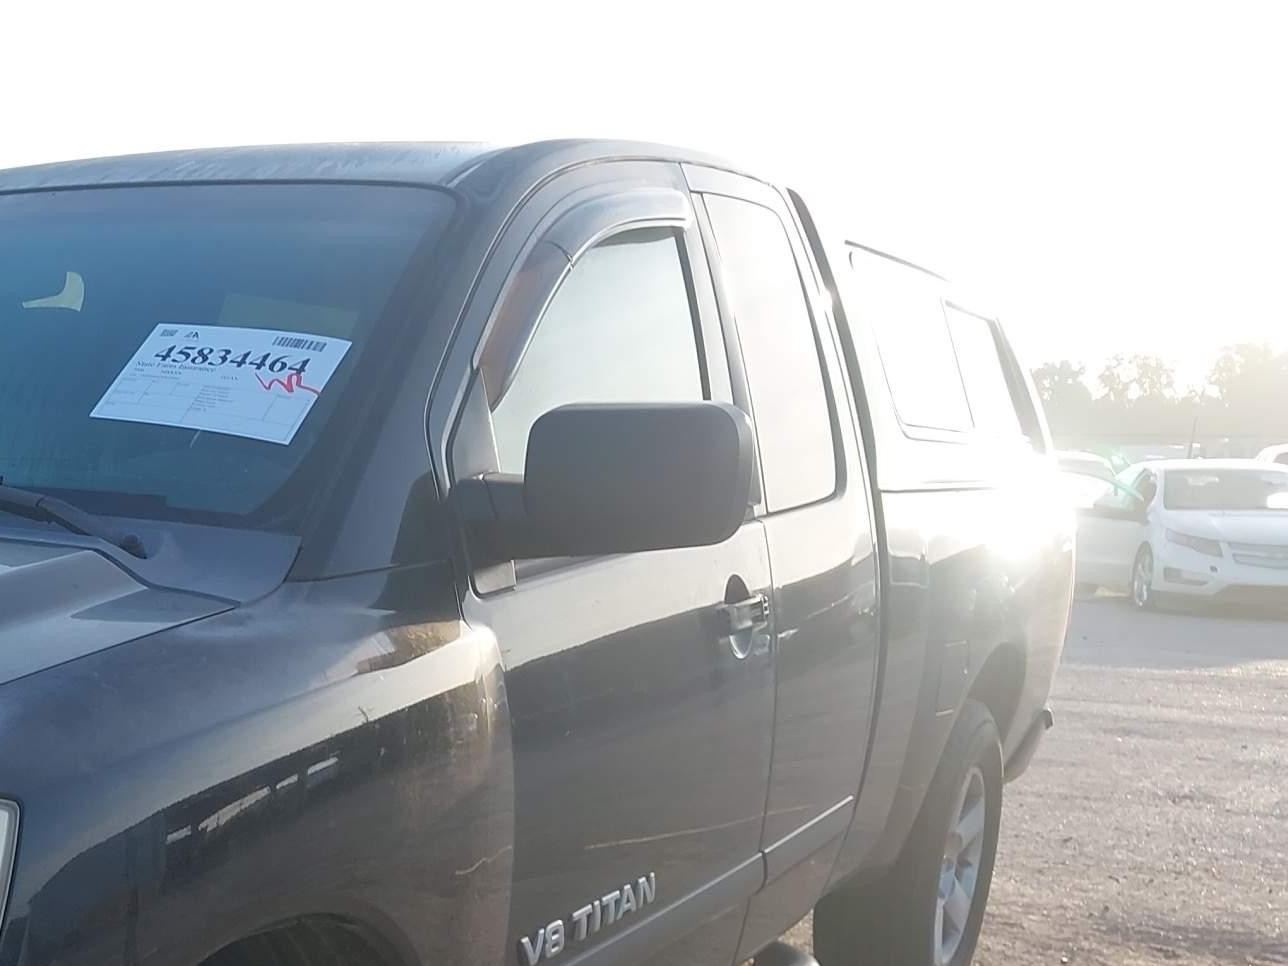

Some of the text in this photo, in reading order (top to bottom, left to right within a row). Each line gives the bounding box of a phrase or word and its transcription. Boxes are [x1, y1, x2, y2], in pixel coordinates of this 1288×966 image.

[154, 344, 311, 376] 45834464
[520, 872, 656, 966] V8 TITAN
